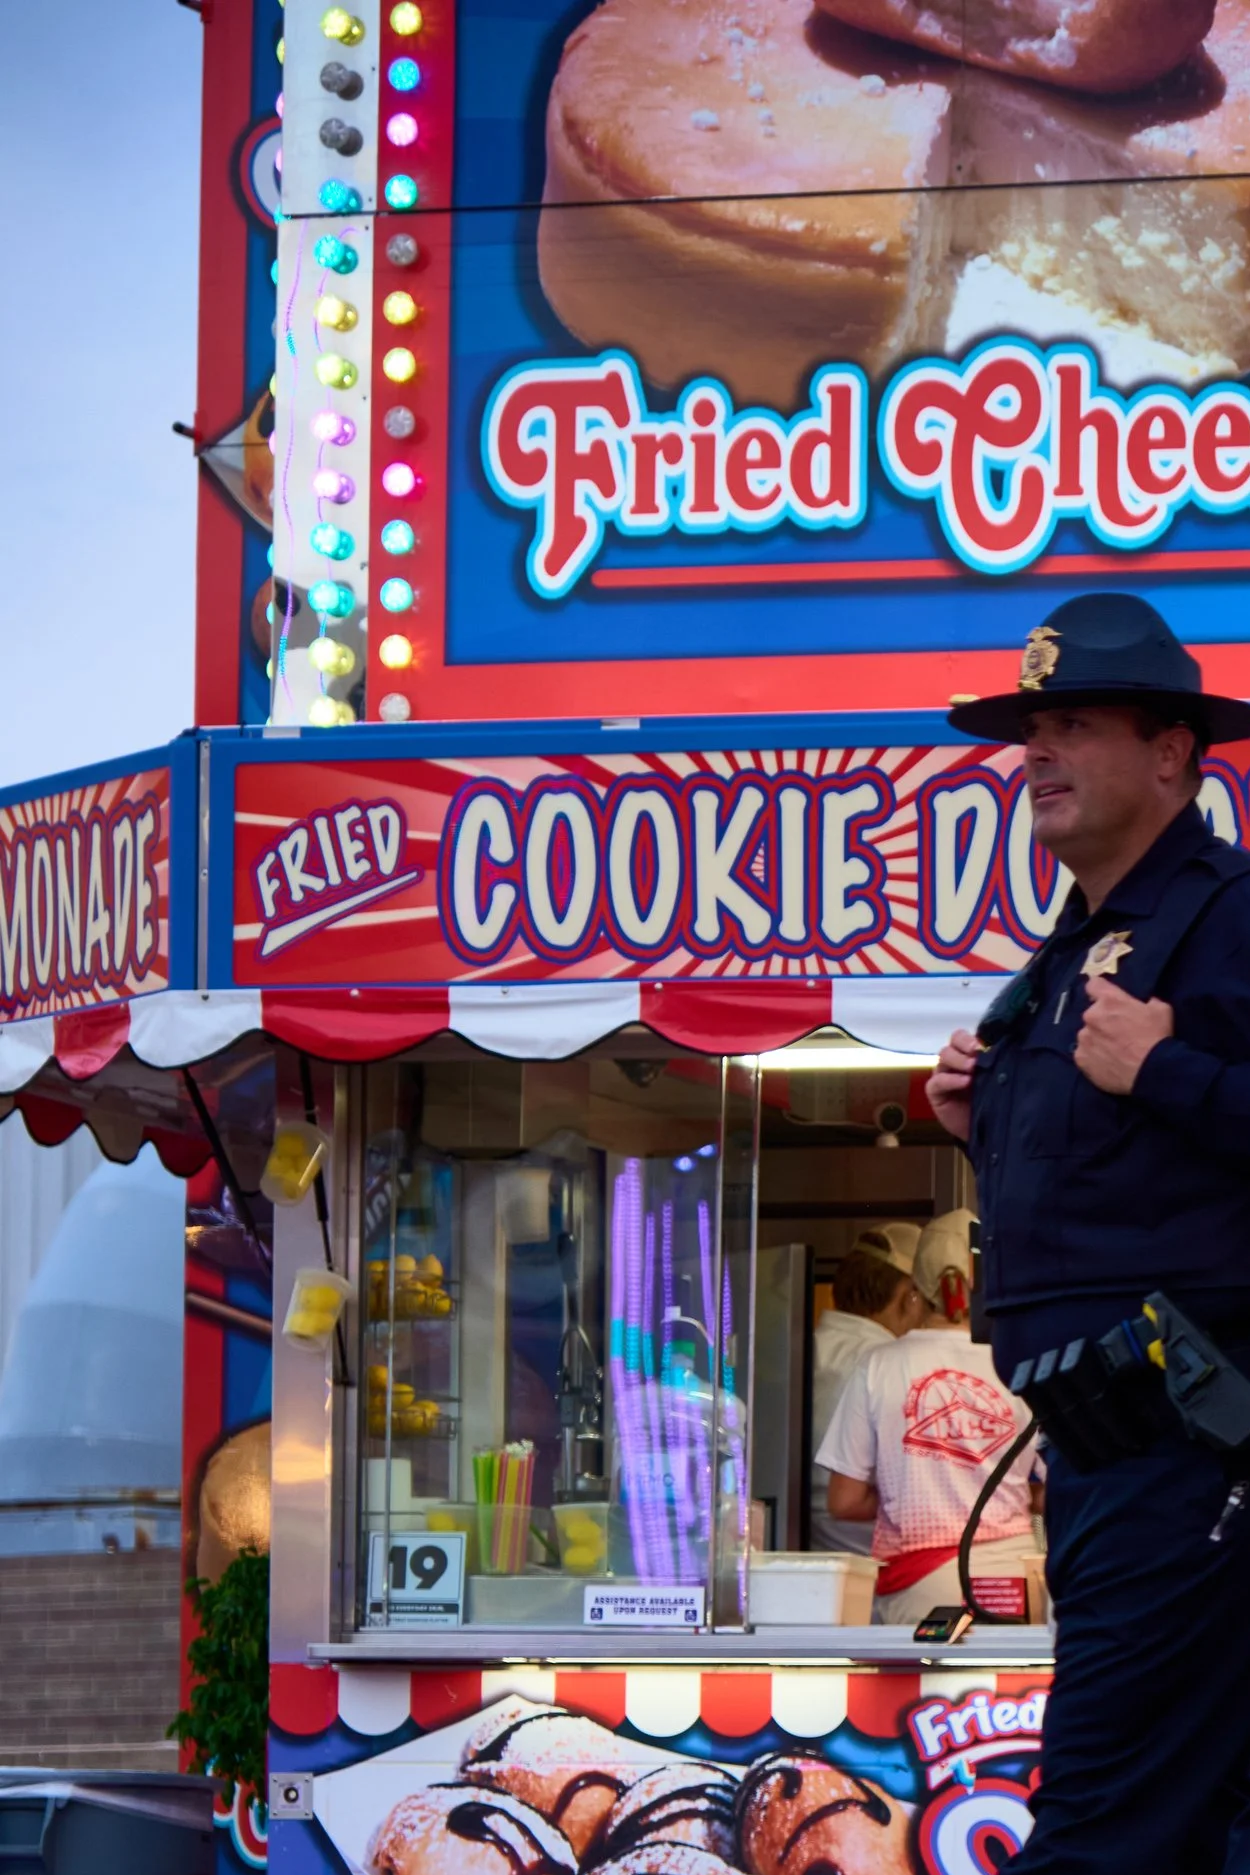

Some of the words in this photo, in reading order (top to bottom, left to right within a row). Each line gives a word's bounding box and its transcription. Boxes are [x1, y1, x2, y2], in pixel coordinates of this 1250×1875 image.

[492, 364, 858, 584] Fried
[256, 803, 401, 919] FRIED
[453, 782, 879, 951] COOKIE
[388, 1544, 449, 1590] 19
[594, 1597, 646, 1607] ASSISTANCE
[649, 1597, 696, 1606] AVAILABLE
[613, 1606, 636, 1615] UPON
[639, 1607, 679, 1616] REQUEST
[913, 1694, 1048, 1758] Fried
